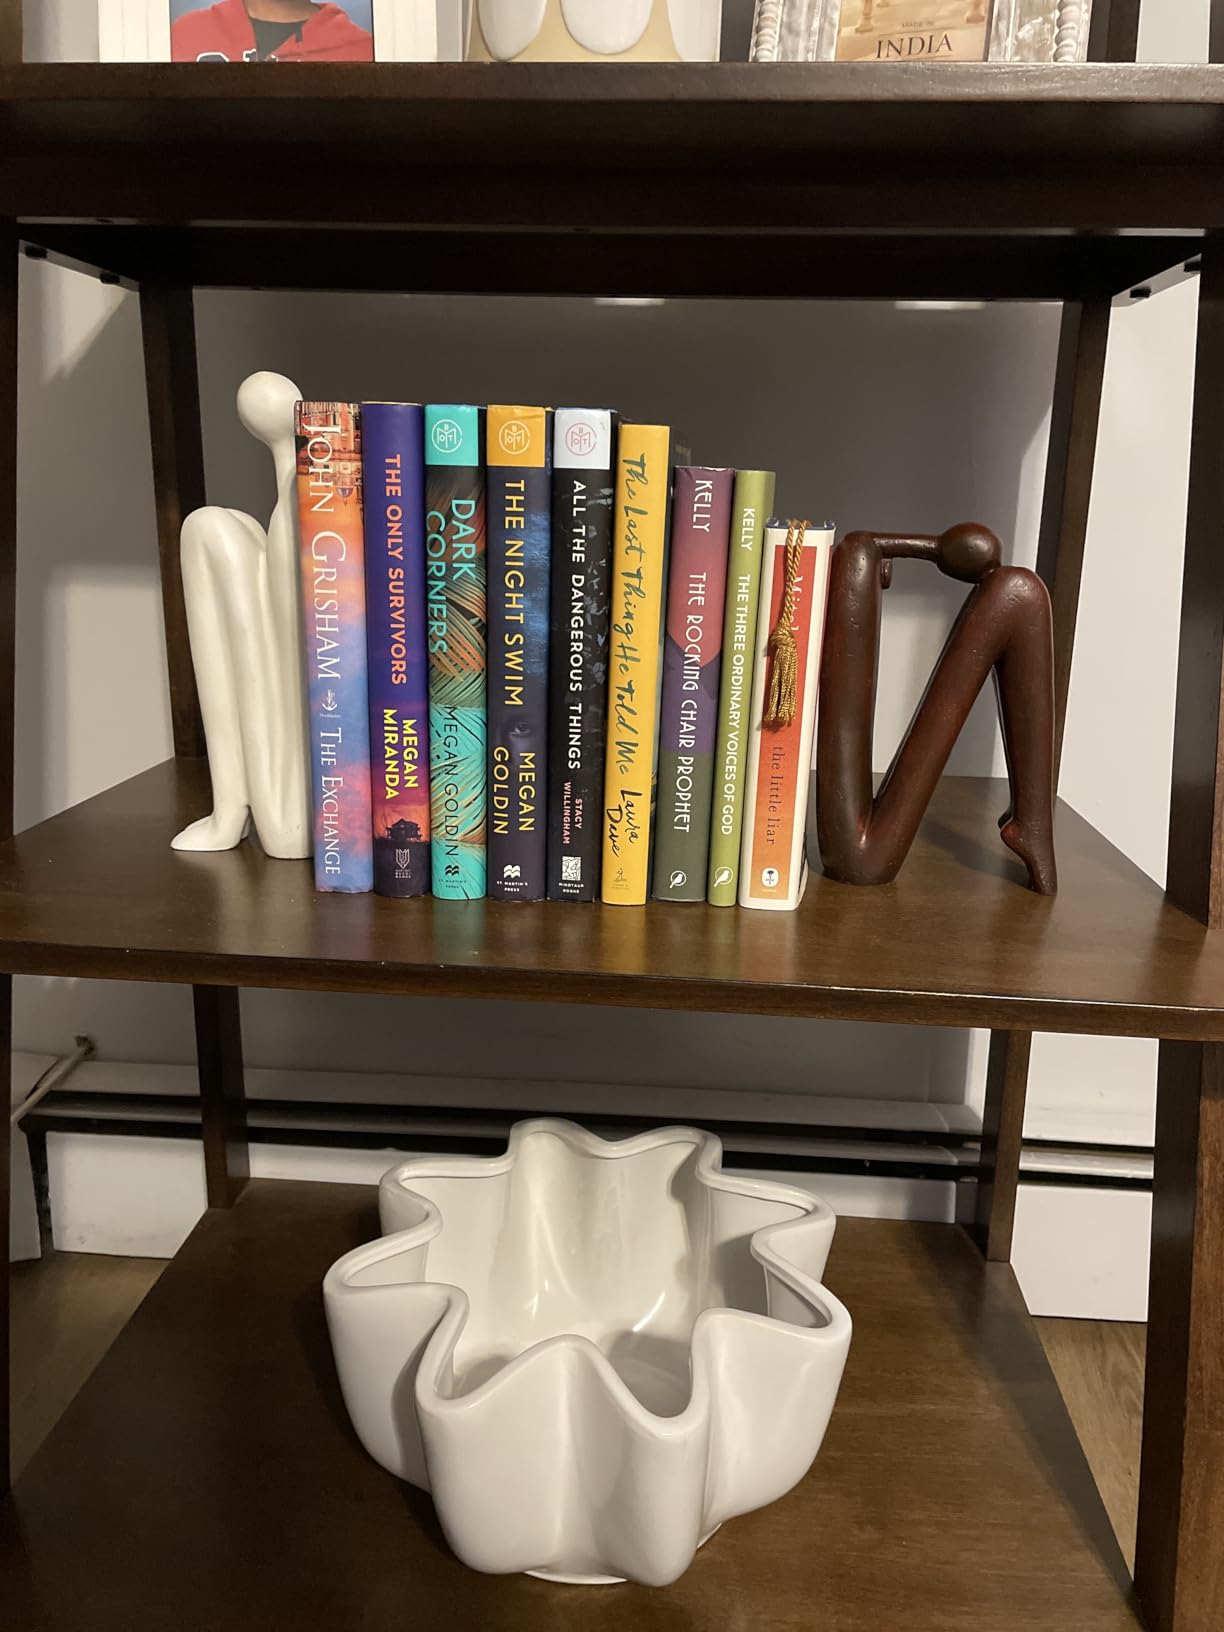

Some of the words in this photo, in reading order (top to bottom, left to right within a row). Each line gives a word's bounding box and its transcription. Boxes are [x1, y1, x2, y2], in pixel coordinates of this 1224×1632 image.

[876, 34, 952, 58] INDIA
[302, 422, 342, 513] JOHN
[385, 454, 402, 497] THE
[622, 453, 648, 501] The
[504, 479, 525, 529] THE
[571, 480, 587, 517] ALL
[693, 480, 714, 533] KELLY
[386, 504, 403, 561] ONLY
[451, 499, 477, 582] DARK
[571, 525, 587, 563] THE
[621, 508, 649, 563] Last
[741, 508, 756, 552] KELLY
[311, 531, 347, 680] GRISHAM
[426, 510, 448, 653] CORNERS
[504, 540, 525, 624] NIGHT
[612, 565, 647, 638] Thing
[687, 572, 707, 606] THE
[738, 575, 751, 601] THE
[388, 569, 407, 686] SURVIVORS
[569, 573, 586, 692] DANGEROUS
[682, 615, 705, 692] ROCKING
[733, 604, 749, 651] THREE
[504, 633, 526, 706] SWIM
[612, 643, 641, 674] He
[615, 680, 639, 738] Told
[727, 653, 745, 728] ORDINARY
[319, 728, 342, 766] THE
[443, 707, 459, 776] MEGAN
[567, 702, 584, 770] THINGS
[678, 699, 698, 749] CHAIR
[383, 708, 399, 800] MIRANDA
[402, 718, 419, 788] MEGAN
[614, 740, 640, 776] Me
[725, 729, 738, 782] VOICES
[770, 746, 786, 770] the
[493, 746, 510, 835] GOLDIN
[519, 752, 537, 832] MEGAN
[563, 782, 572, 845] WILLINGHAM
[574, 798, 583, 829] STACY
[621, 789, 643, 844] Laura
[674, 756, 695, 834] PROPHET
[723, 786, 736, 803] OF
[768, 774, 784, 814] little
[321, 776, 343, 875] EXCHANGE
[444, 783, 460, 857] GOLDIN
[606, 804, 624, 858] Dave
[721, 806, 734, 835] GOD
[766, 816, 781, 845] liar
